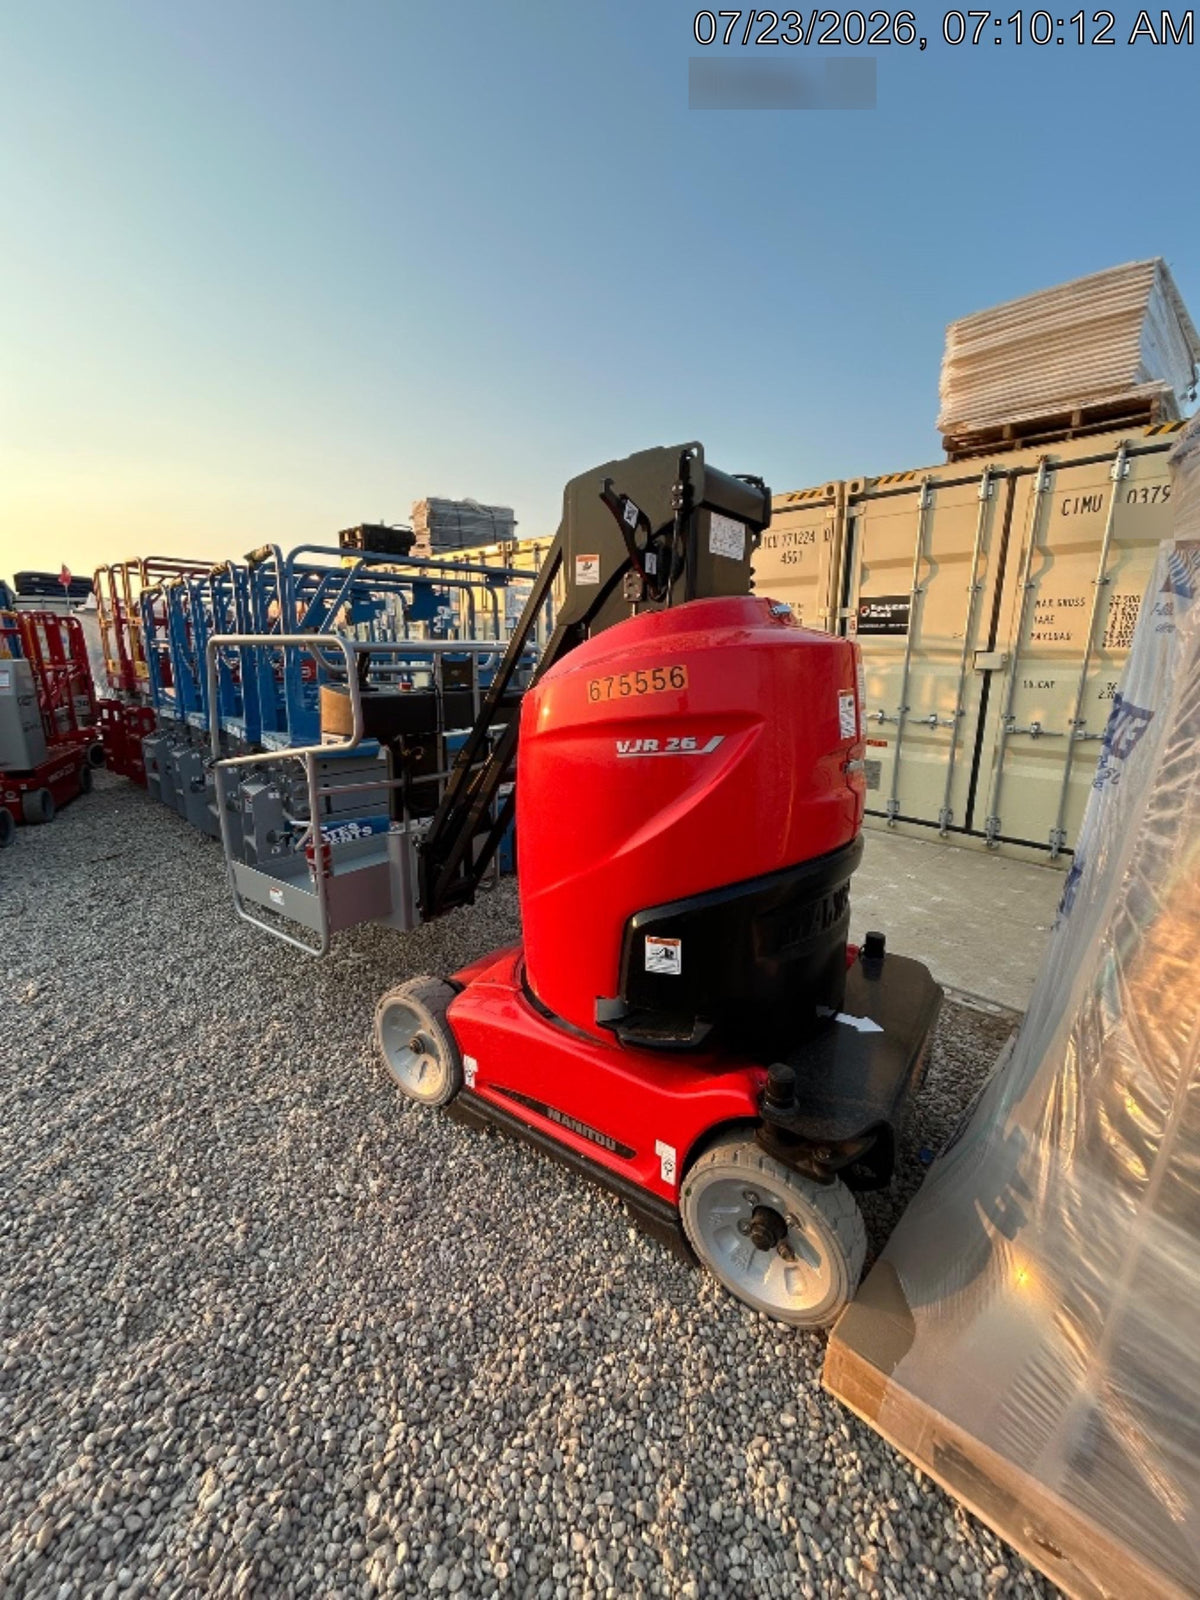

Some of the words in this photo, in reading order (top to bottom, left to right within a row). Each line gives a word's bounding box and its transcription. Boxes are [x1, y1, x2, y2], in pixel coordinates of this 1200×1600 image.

[1061, 494, 1103, 516] CIMU
[589, 666, 686, 701] 675556
[616, 739, 660, 753] VJR
[665, 737, 697, 751] 26
[547, 1107, 617, 1151] MANITOU
